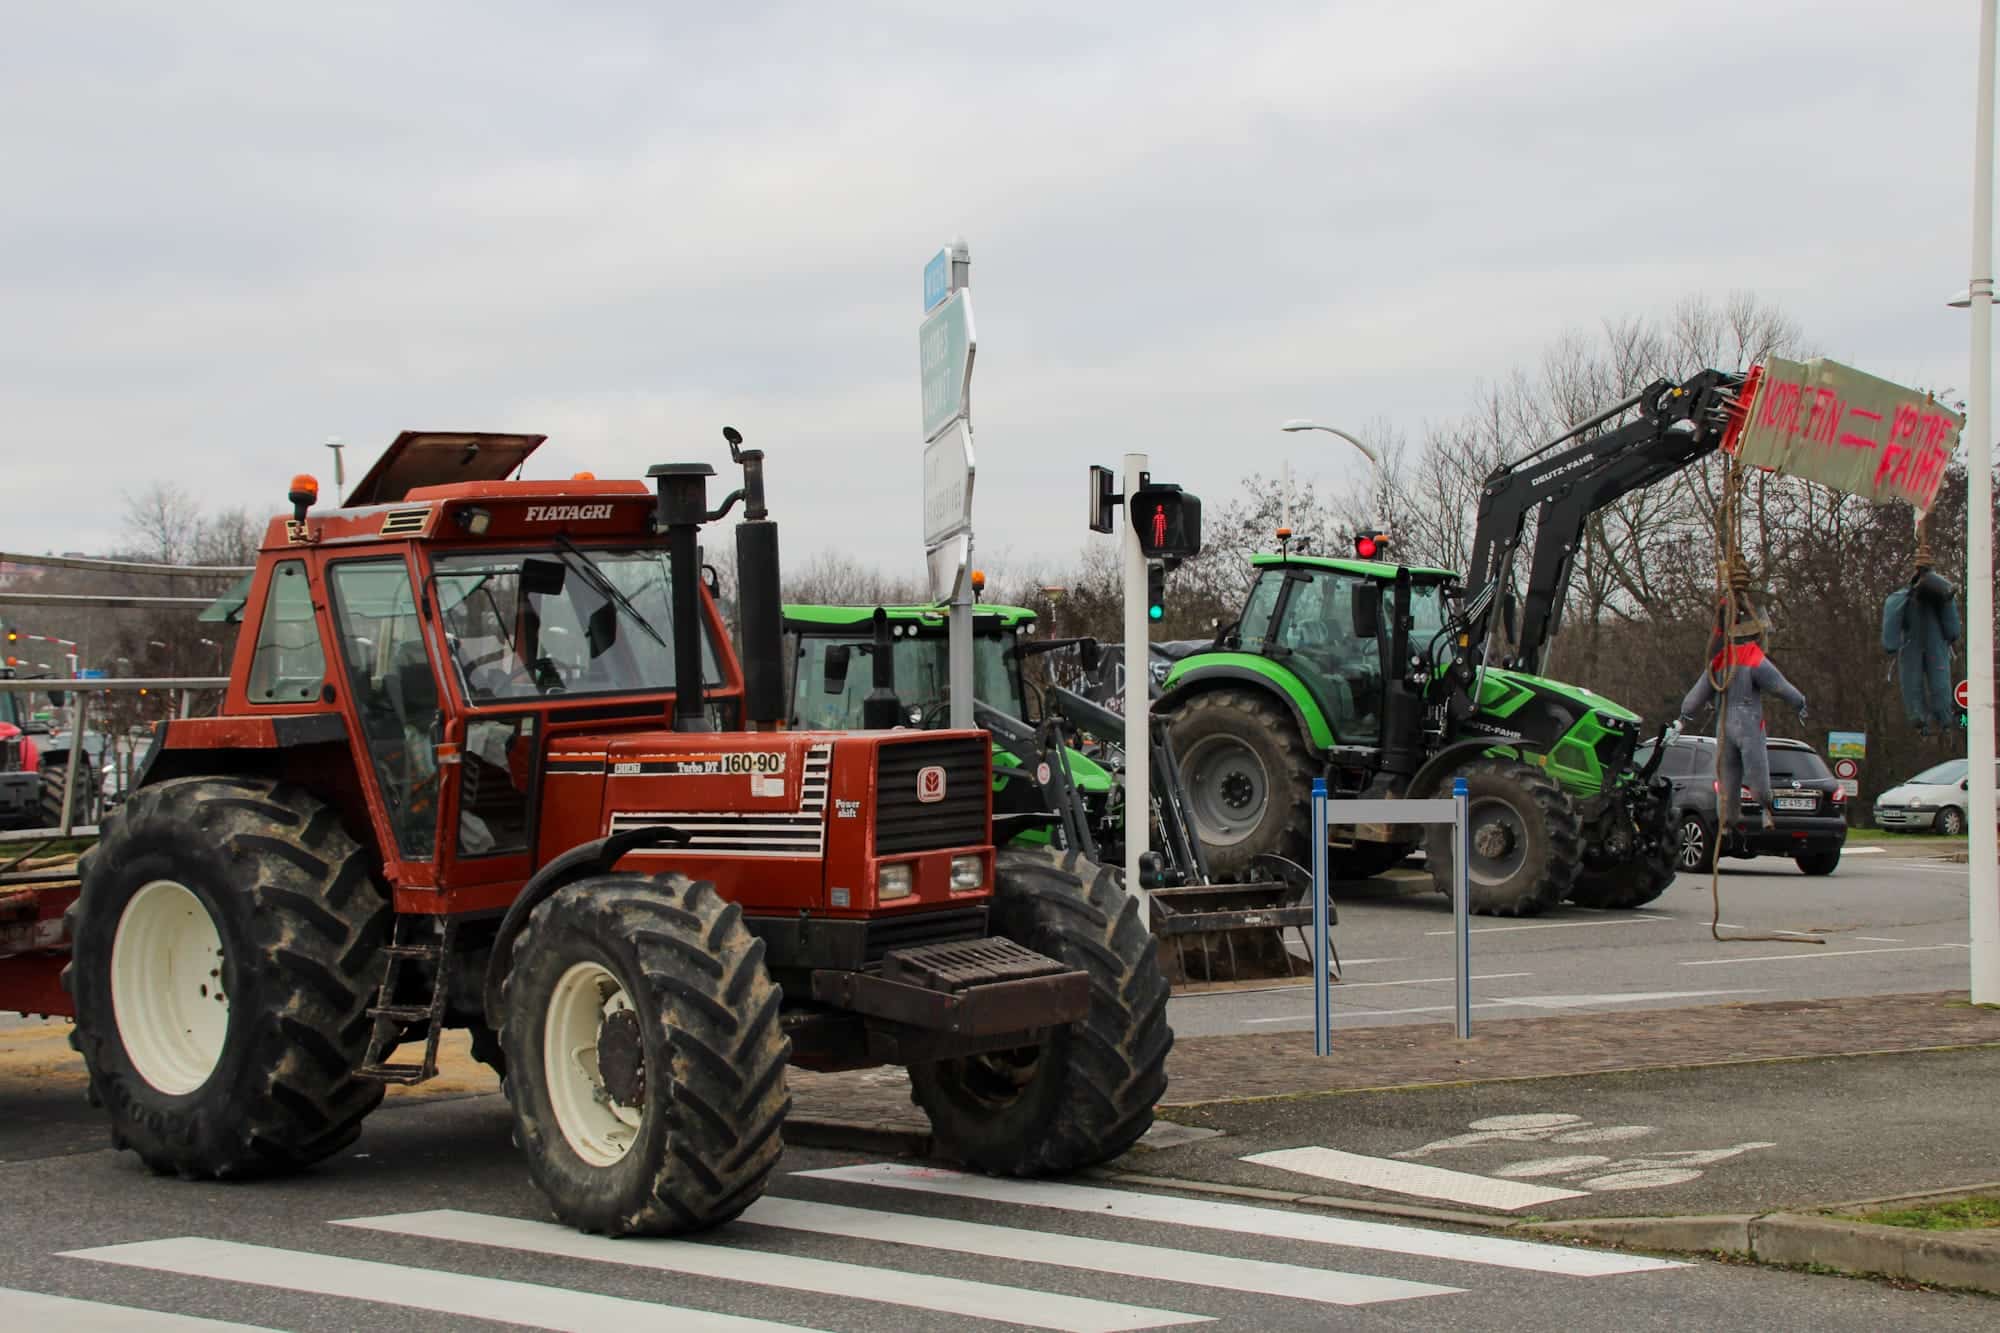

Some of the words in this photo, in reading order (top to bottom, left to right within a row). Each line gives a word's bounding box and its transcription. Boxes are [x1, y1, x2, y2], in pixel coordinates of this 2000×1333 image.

[1756, 377, 1813, 434] NOTRE
[1803, 387, 1847, 449] FIN
[1888, 403, 1953, 456] VOTRE
[1531, 453, 1594, 487] DEUTZ-FAHR
[525, 504, 614, 521] FIATAGRI
[1471, 721, 1521, 737] UTZ-FAHR
[677, 762, 703, 773] Turbo
[835, 799, 860, 808] Power
